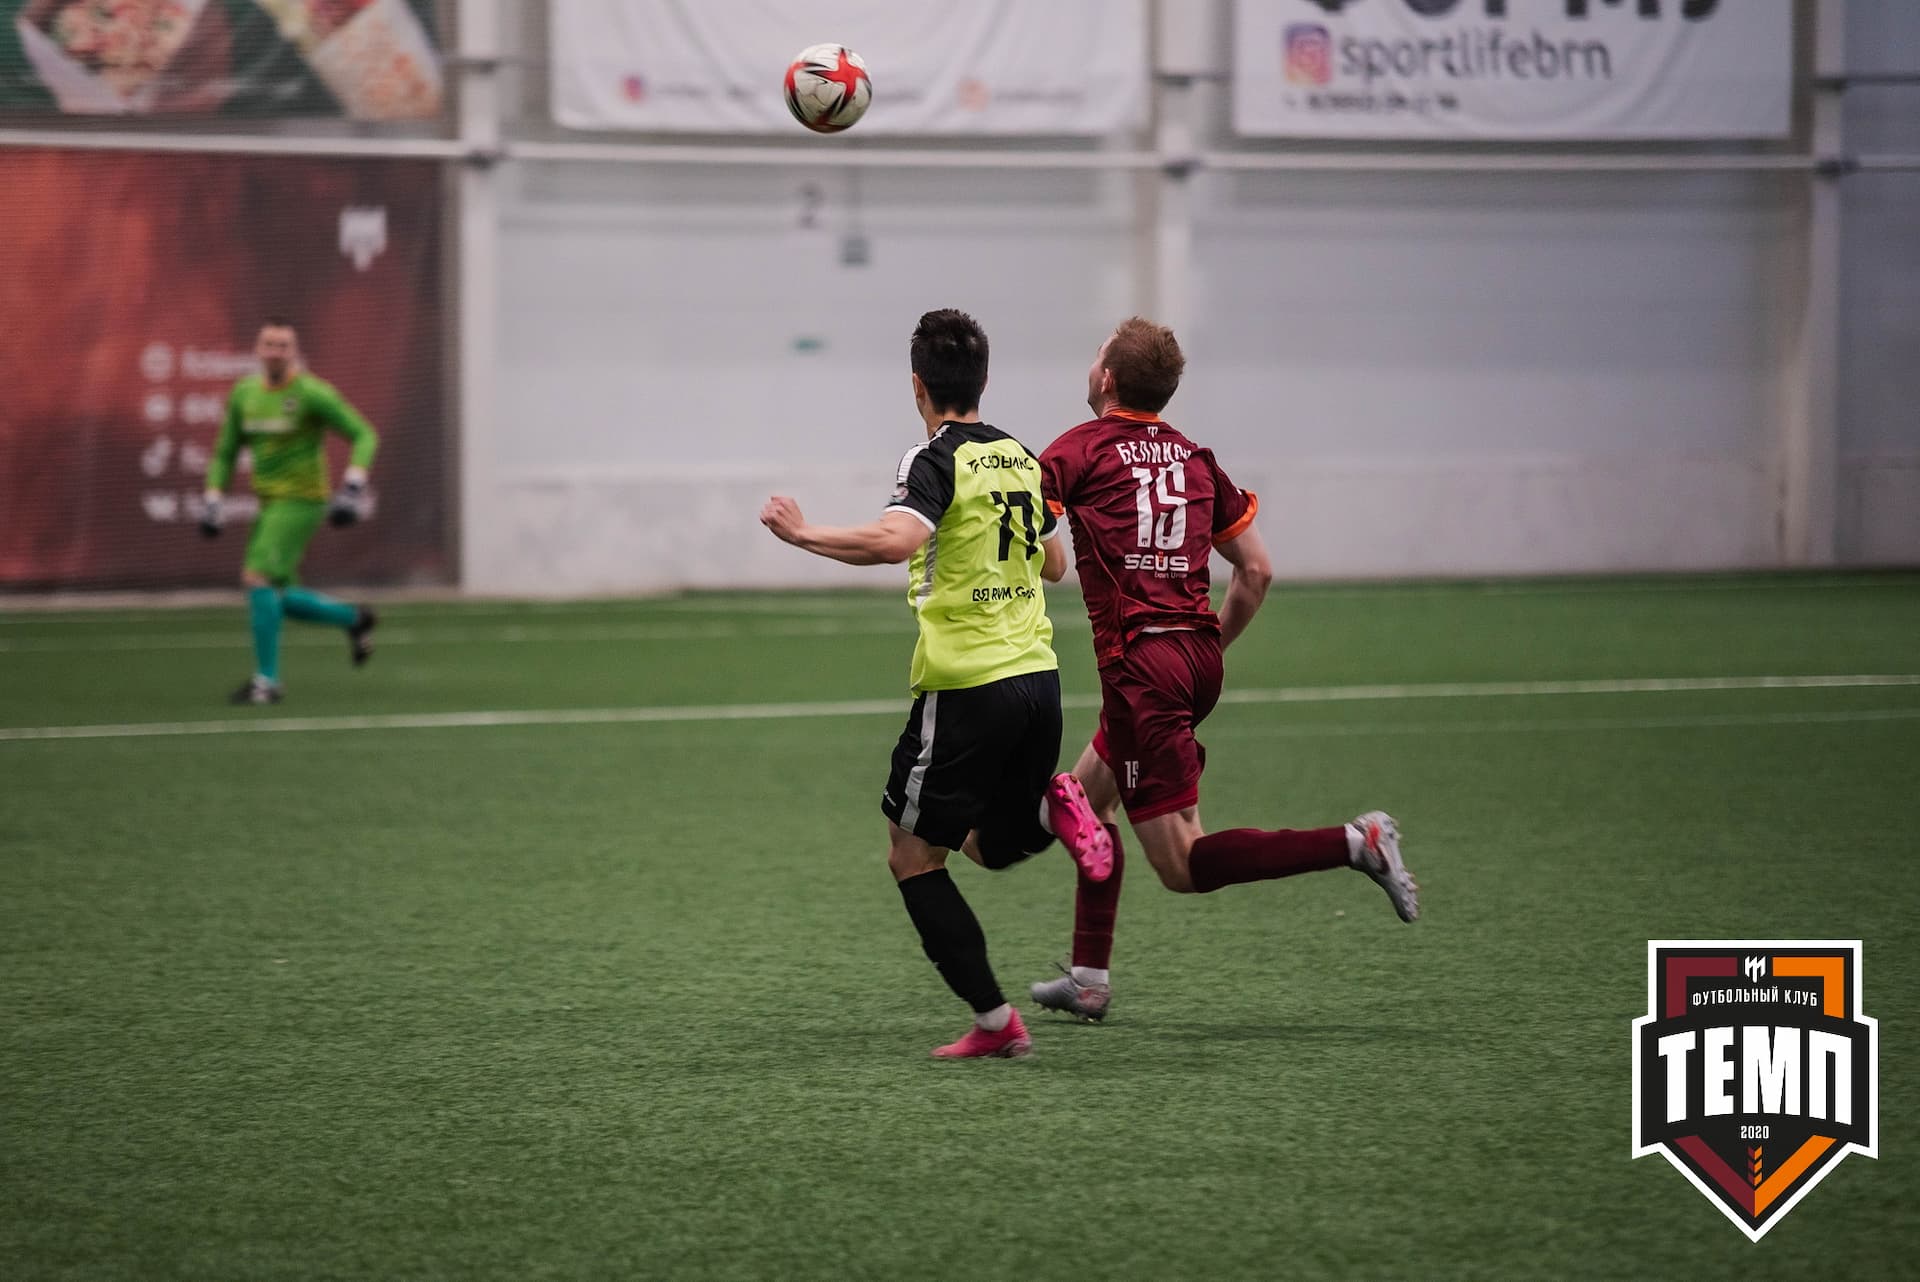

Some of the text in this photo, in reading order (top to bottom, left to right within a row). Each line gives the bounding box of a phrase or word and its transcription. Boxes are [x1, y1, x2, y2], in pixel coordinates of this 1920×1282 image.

[1340, 29, 1613, 83] sportlifebrn
[1131, 461, 1188, 550] 15
[1124, 760, 1139, 789] 15
